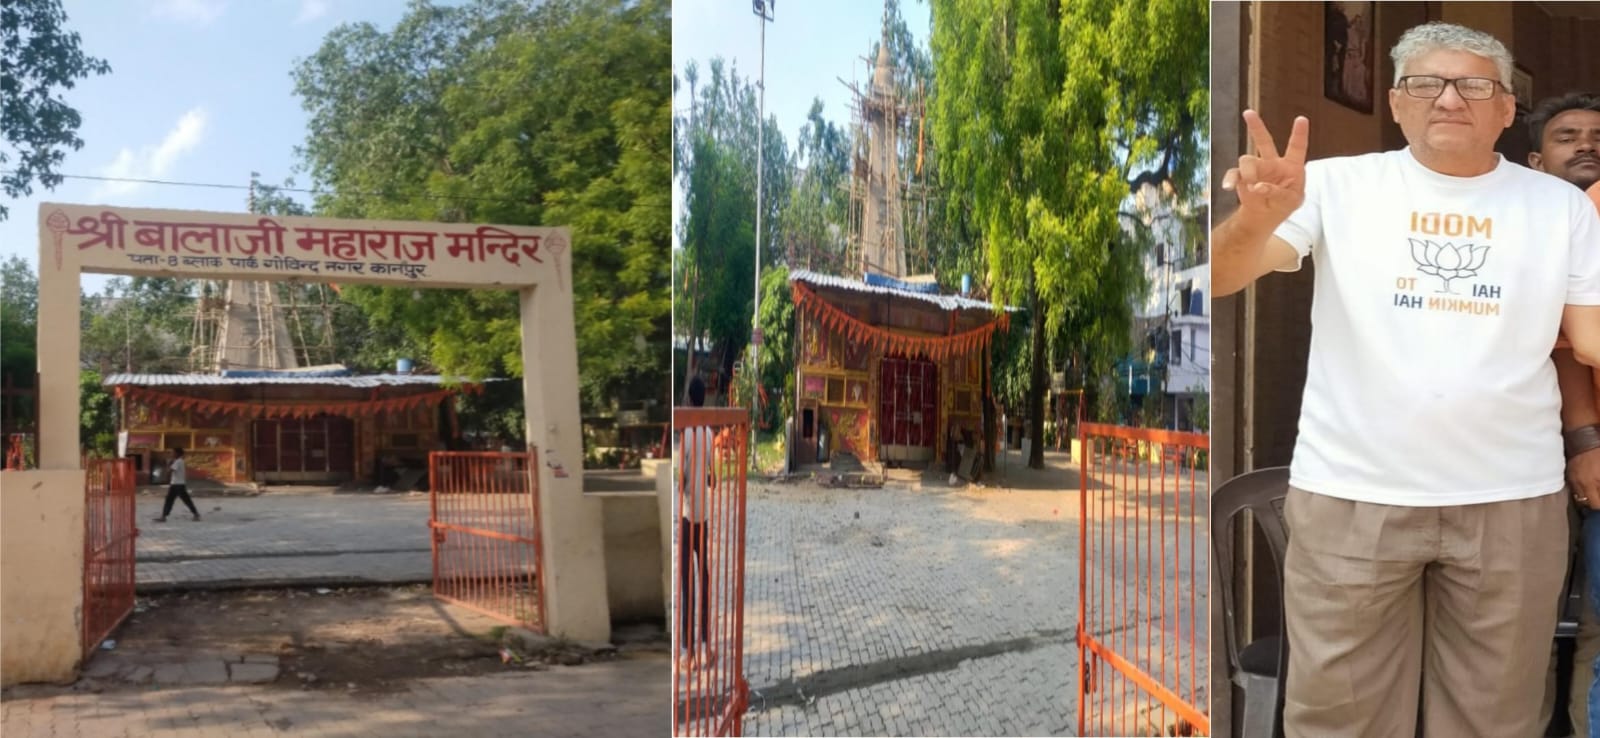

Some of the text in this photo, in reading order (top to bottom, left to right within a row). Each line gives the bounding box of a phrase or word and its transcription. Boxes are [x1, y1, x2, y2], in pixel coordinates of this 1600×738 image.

[68, 211, 544, 267] श्री बालाजी महाराज मन्दिर
[182, 256, 223, 268] ब्लाक
[227, 256, 259, 268] पार्क
[263, 256, 320, 273] गोविन्द
[325, 261, 365, 275] नगर
[370, 261, 427, 278] कानपुर
